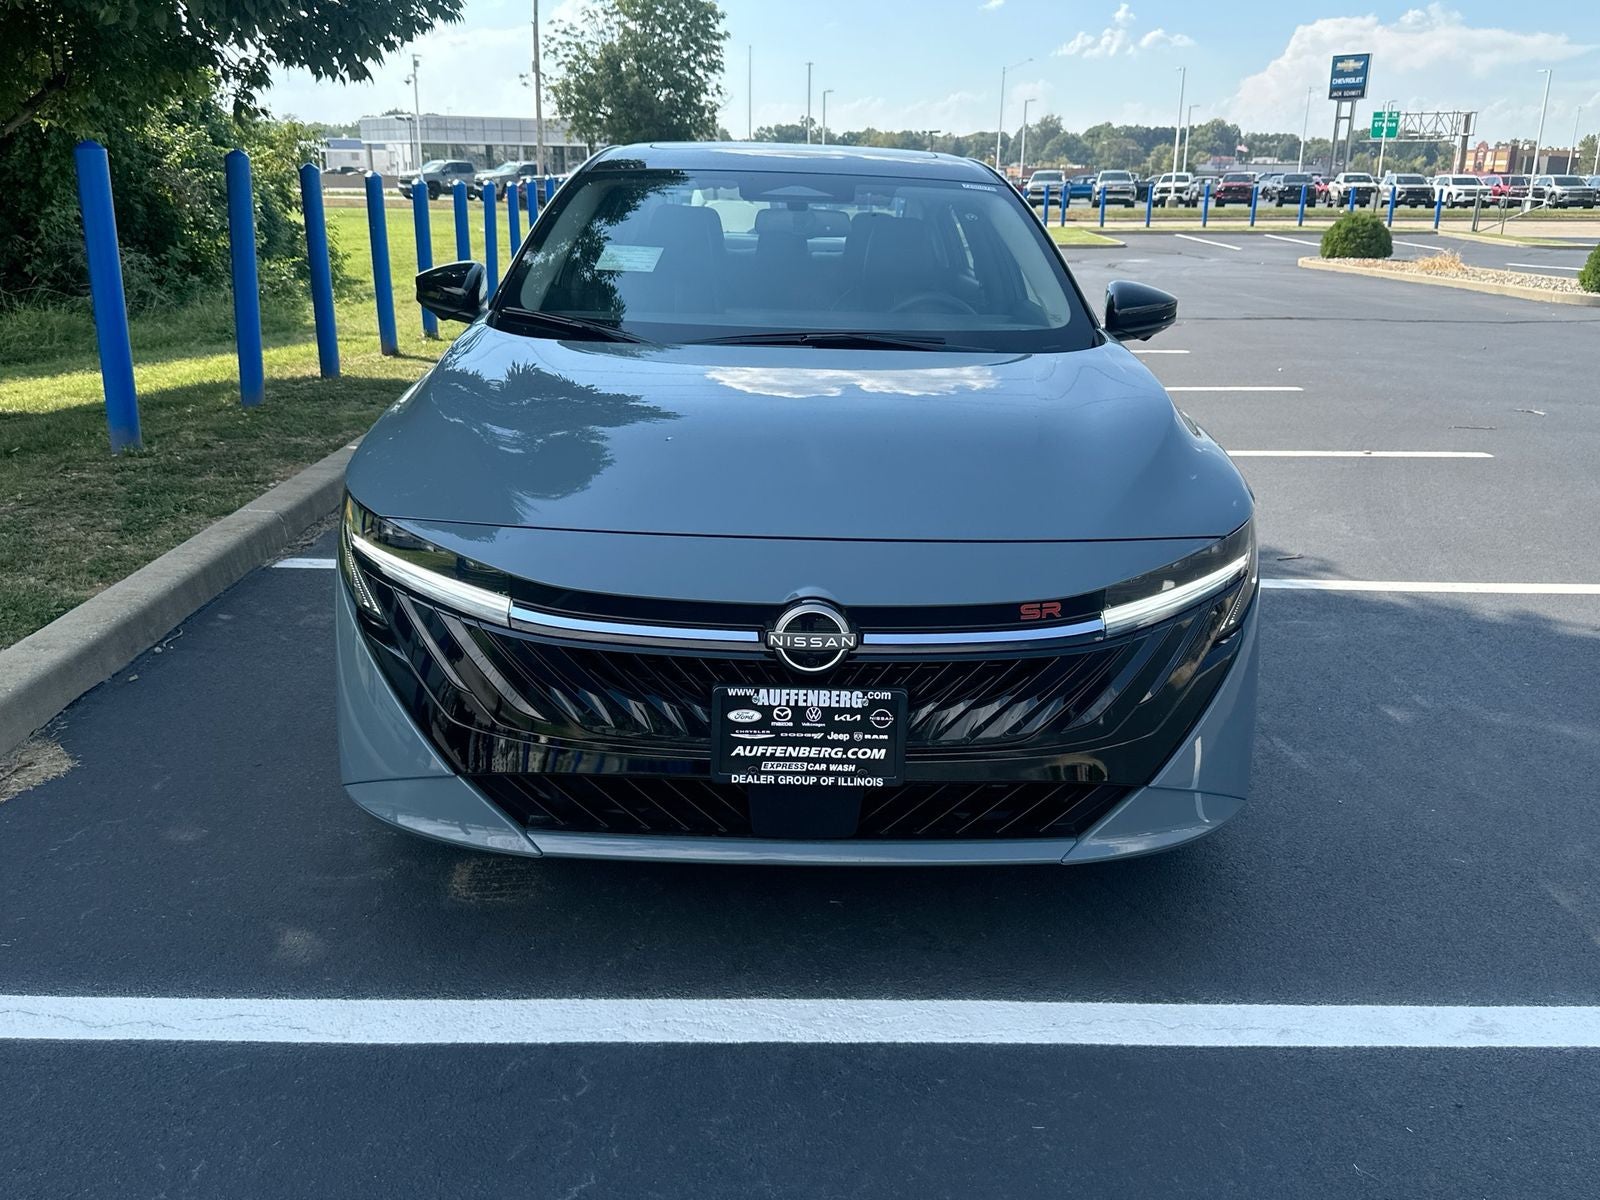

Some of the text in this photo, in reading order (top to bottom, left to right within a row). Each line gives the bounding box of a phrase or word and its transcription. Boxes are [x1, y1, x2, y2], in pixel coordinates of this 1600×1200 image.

[1332, 77, 1363, 85] CHEVROLET
[1019, 602, 1062, 621] SR
[770, 634, 856, 649] NISSAN
[734, 711, 755, 721] Ford
[827, 731, 850, 742] Jeep
[730, 745, 886, 760] AUFFENBERG.COM
[762, 762, 856, 772] EXPRESS CAR WASH
[731, 774, 884, 787] DEALER GROUP OF ILLINOIS
